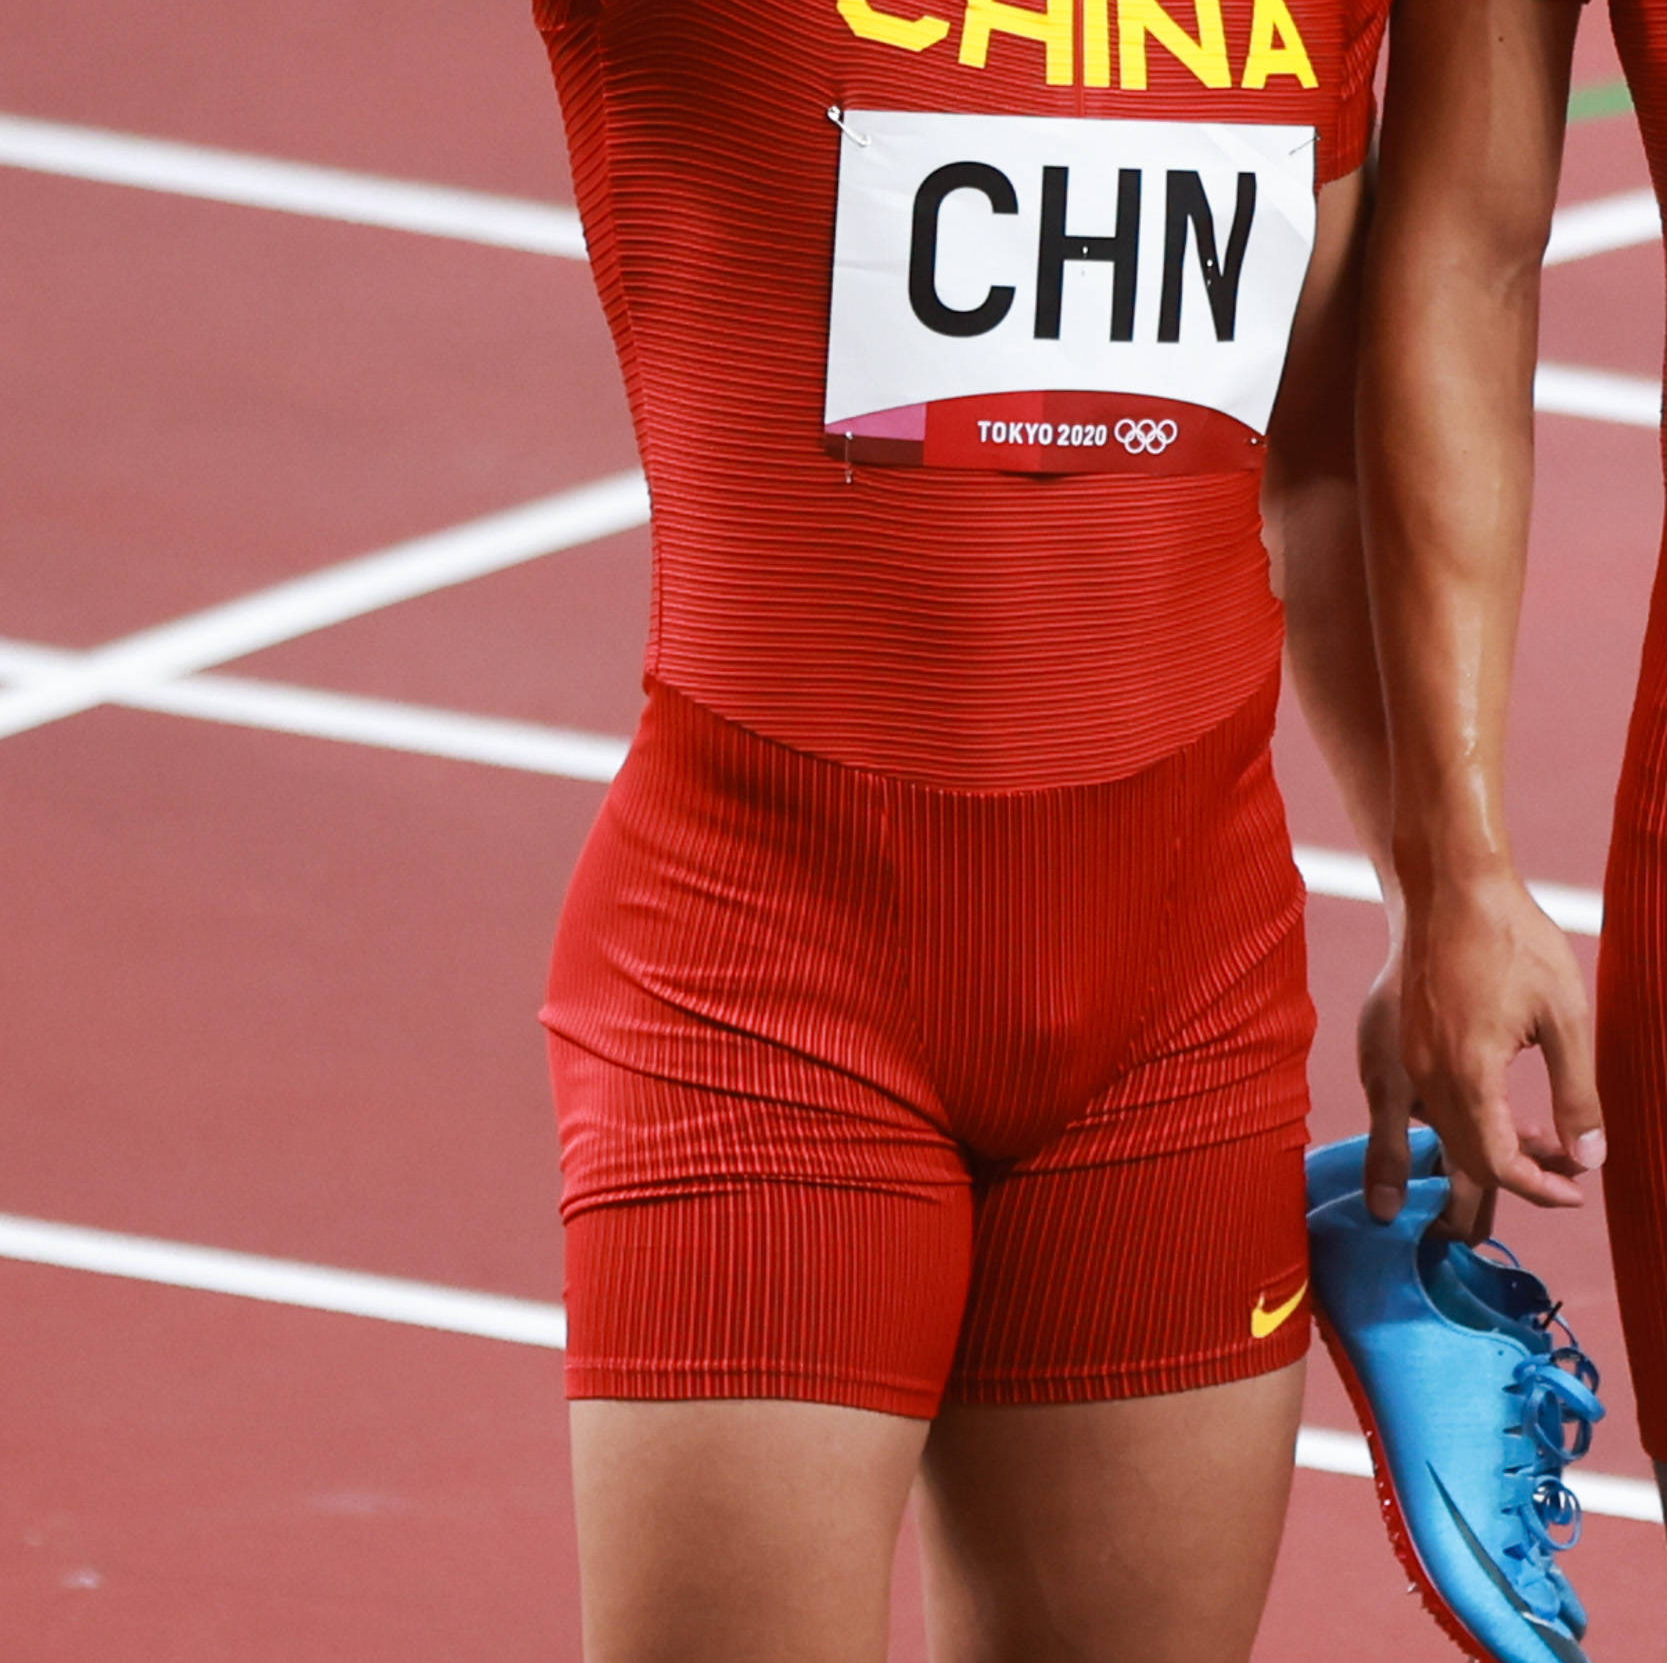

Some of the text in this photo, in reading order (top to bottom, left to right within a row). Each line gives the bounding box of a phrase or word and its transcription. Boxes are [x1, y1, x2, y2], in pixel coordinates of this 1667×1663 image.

[908, 161, 1257, 343] CHN
[976, 420, 1107, 447] TOKYO 2020
